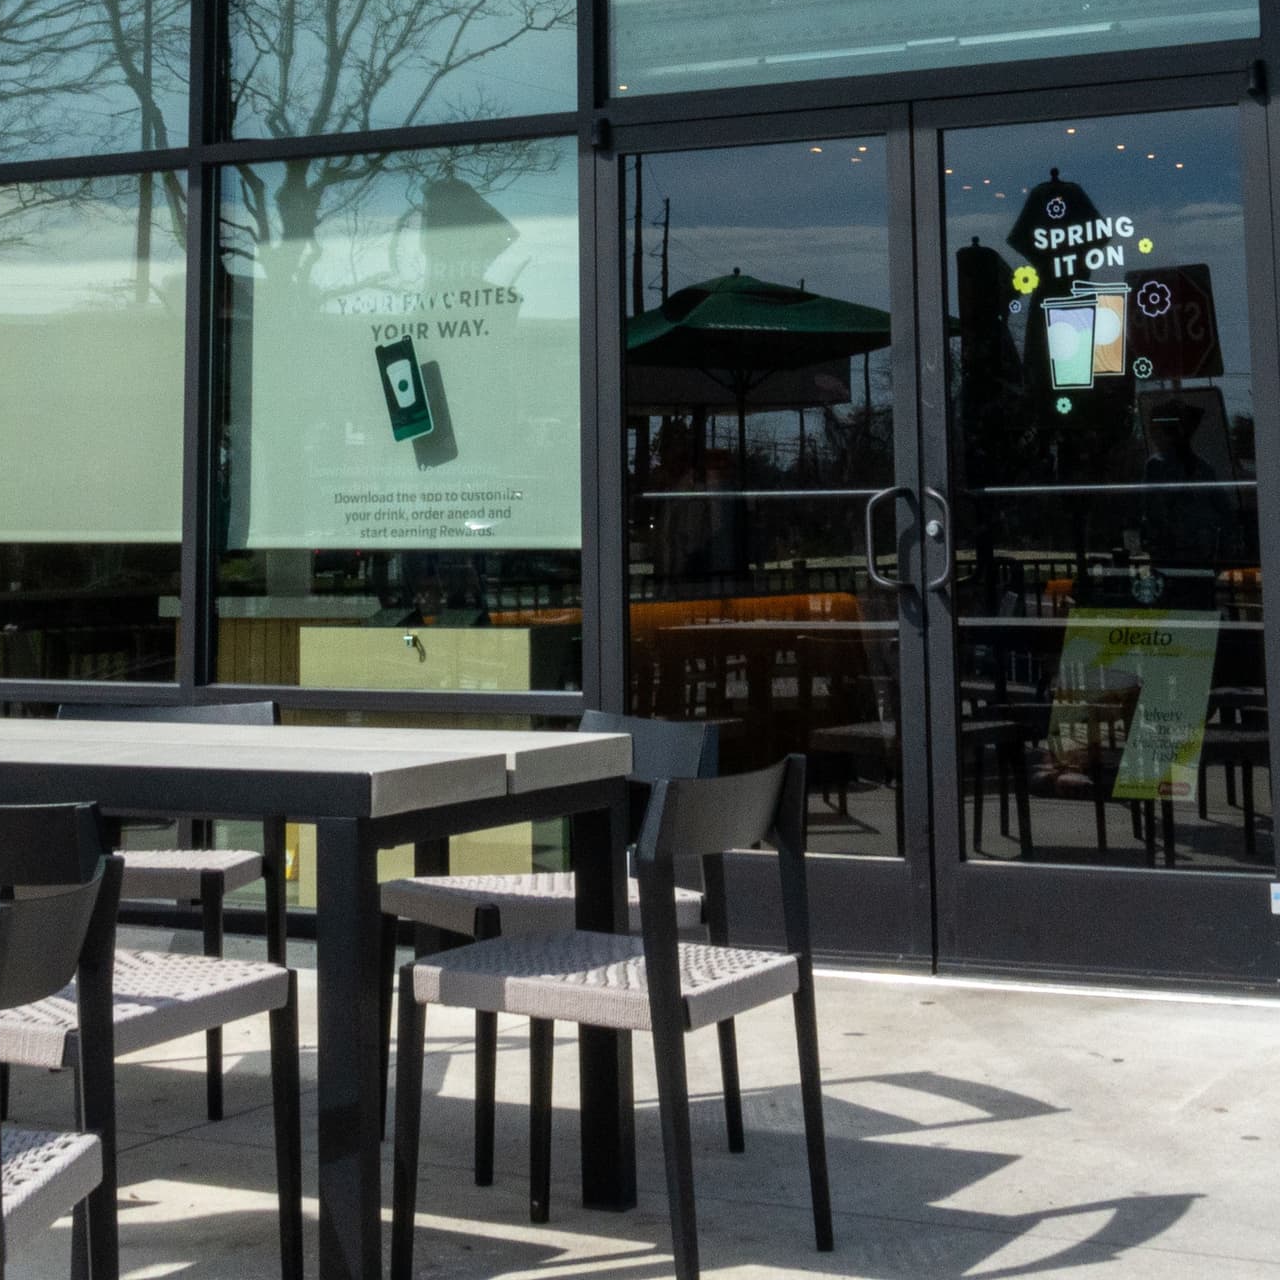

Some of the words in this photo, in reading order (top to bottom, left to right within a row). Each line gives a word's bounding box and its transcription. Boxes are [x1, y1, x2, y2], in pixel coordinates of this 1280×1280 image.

[1033, 216, 1135, 250] SPRING
[1053, 254, 1078, 278] IT
[1085, 245, 1125, 270] ON
[370, 320, 430, 342] YOUR
[438, 319, 490, 339] WAY.
[334, 492, 394, 505] Download
[445, 490, 458, 502] to
[344, 510, 371, 524] your
[374, 508, 409, 522] drink,
[411, 507, 445, 521] order
[447, 507, 485, 520] ahead
[488, 506, 512, 519] and
[360, 526, 387, 538] start
[390, 525, 437, 540] earning
[1108, 627, 1173, 646] Oleato
